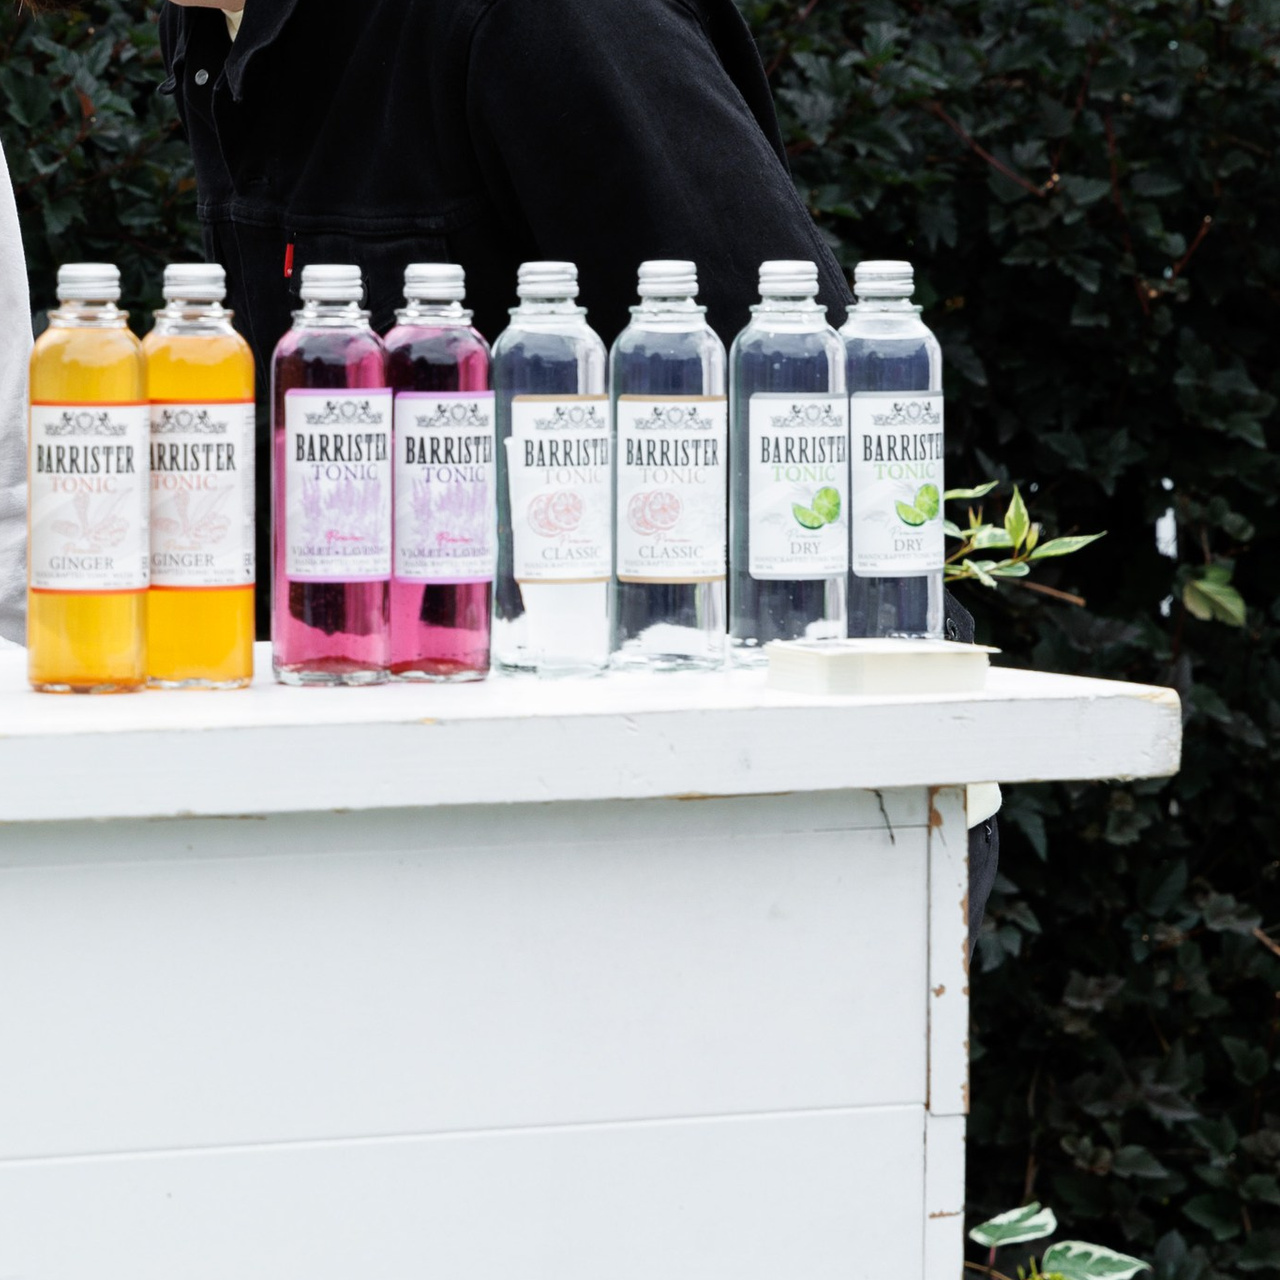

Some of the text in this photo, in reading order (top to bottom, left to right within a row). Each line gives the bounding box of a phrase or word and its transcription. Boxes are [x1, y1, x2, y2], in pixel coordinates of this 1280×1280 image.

[295, 433, 388, 462] BARRISTER
[626, 438, 719, 466] BARRISTER
[37, 445, 135, 473] BARRISTER
[150, 443, 236, 471] ARRISTER
[311, 463, 378, 481] TONIC
[422, 466, 485, 483] TONIC
[542, 468, 603, 484] TONIC
[639, 468, 706, 484] TONIC
[771, 465, 835, 482] TONIC
[874, 462, 935, 480] TONIC
[50, 476, 118, 494] TONIC
[150, 474, 218, 491] TONIC
[541, 546, 602, 561] CLASSIC
[638, 545, 704, 560] CLASSIC
[790, 542, 821, 555] DRY
[894, 538, 924, 552] DRY
[49, 556, 115, 571] GINGER
[150, 553, 215, 567] GINGER
